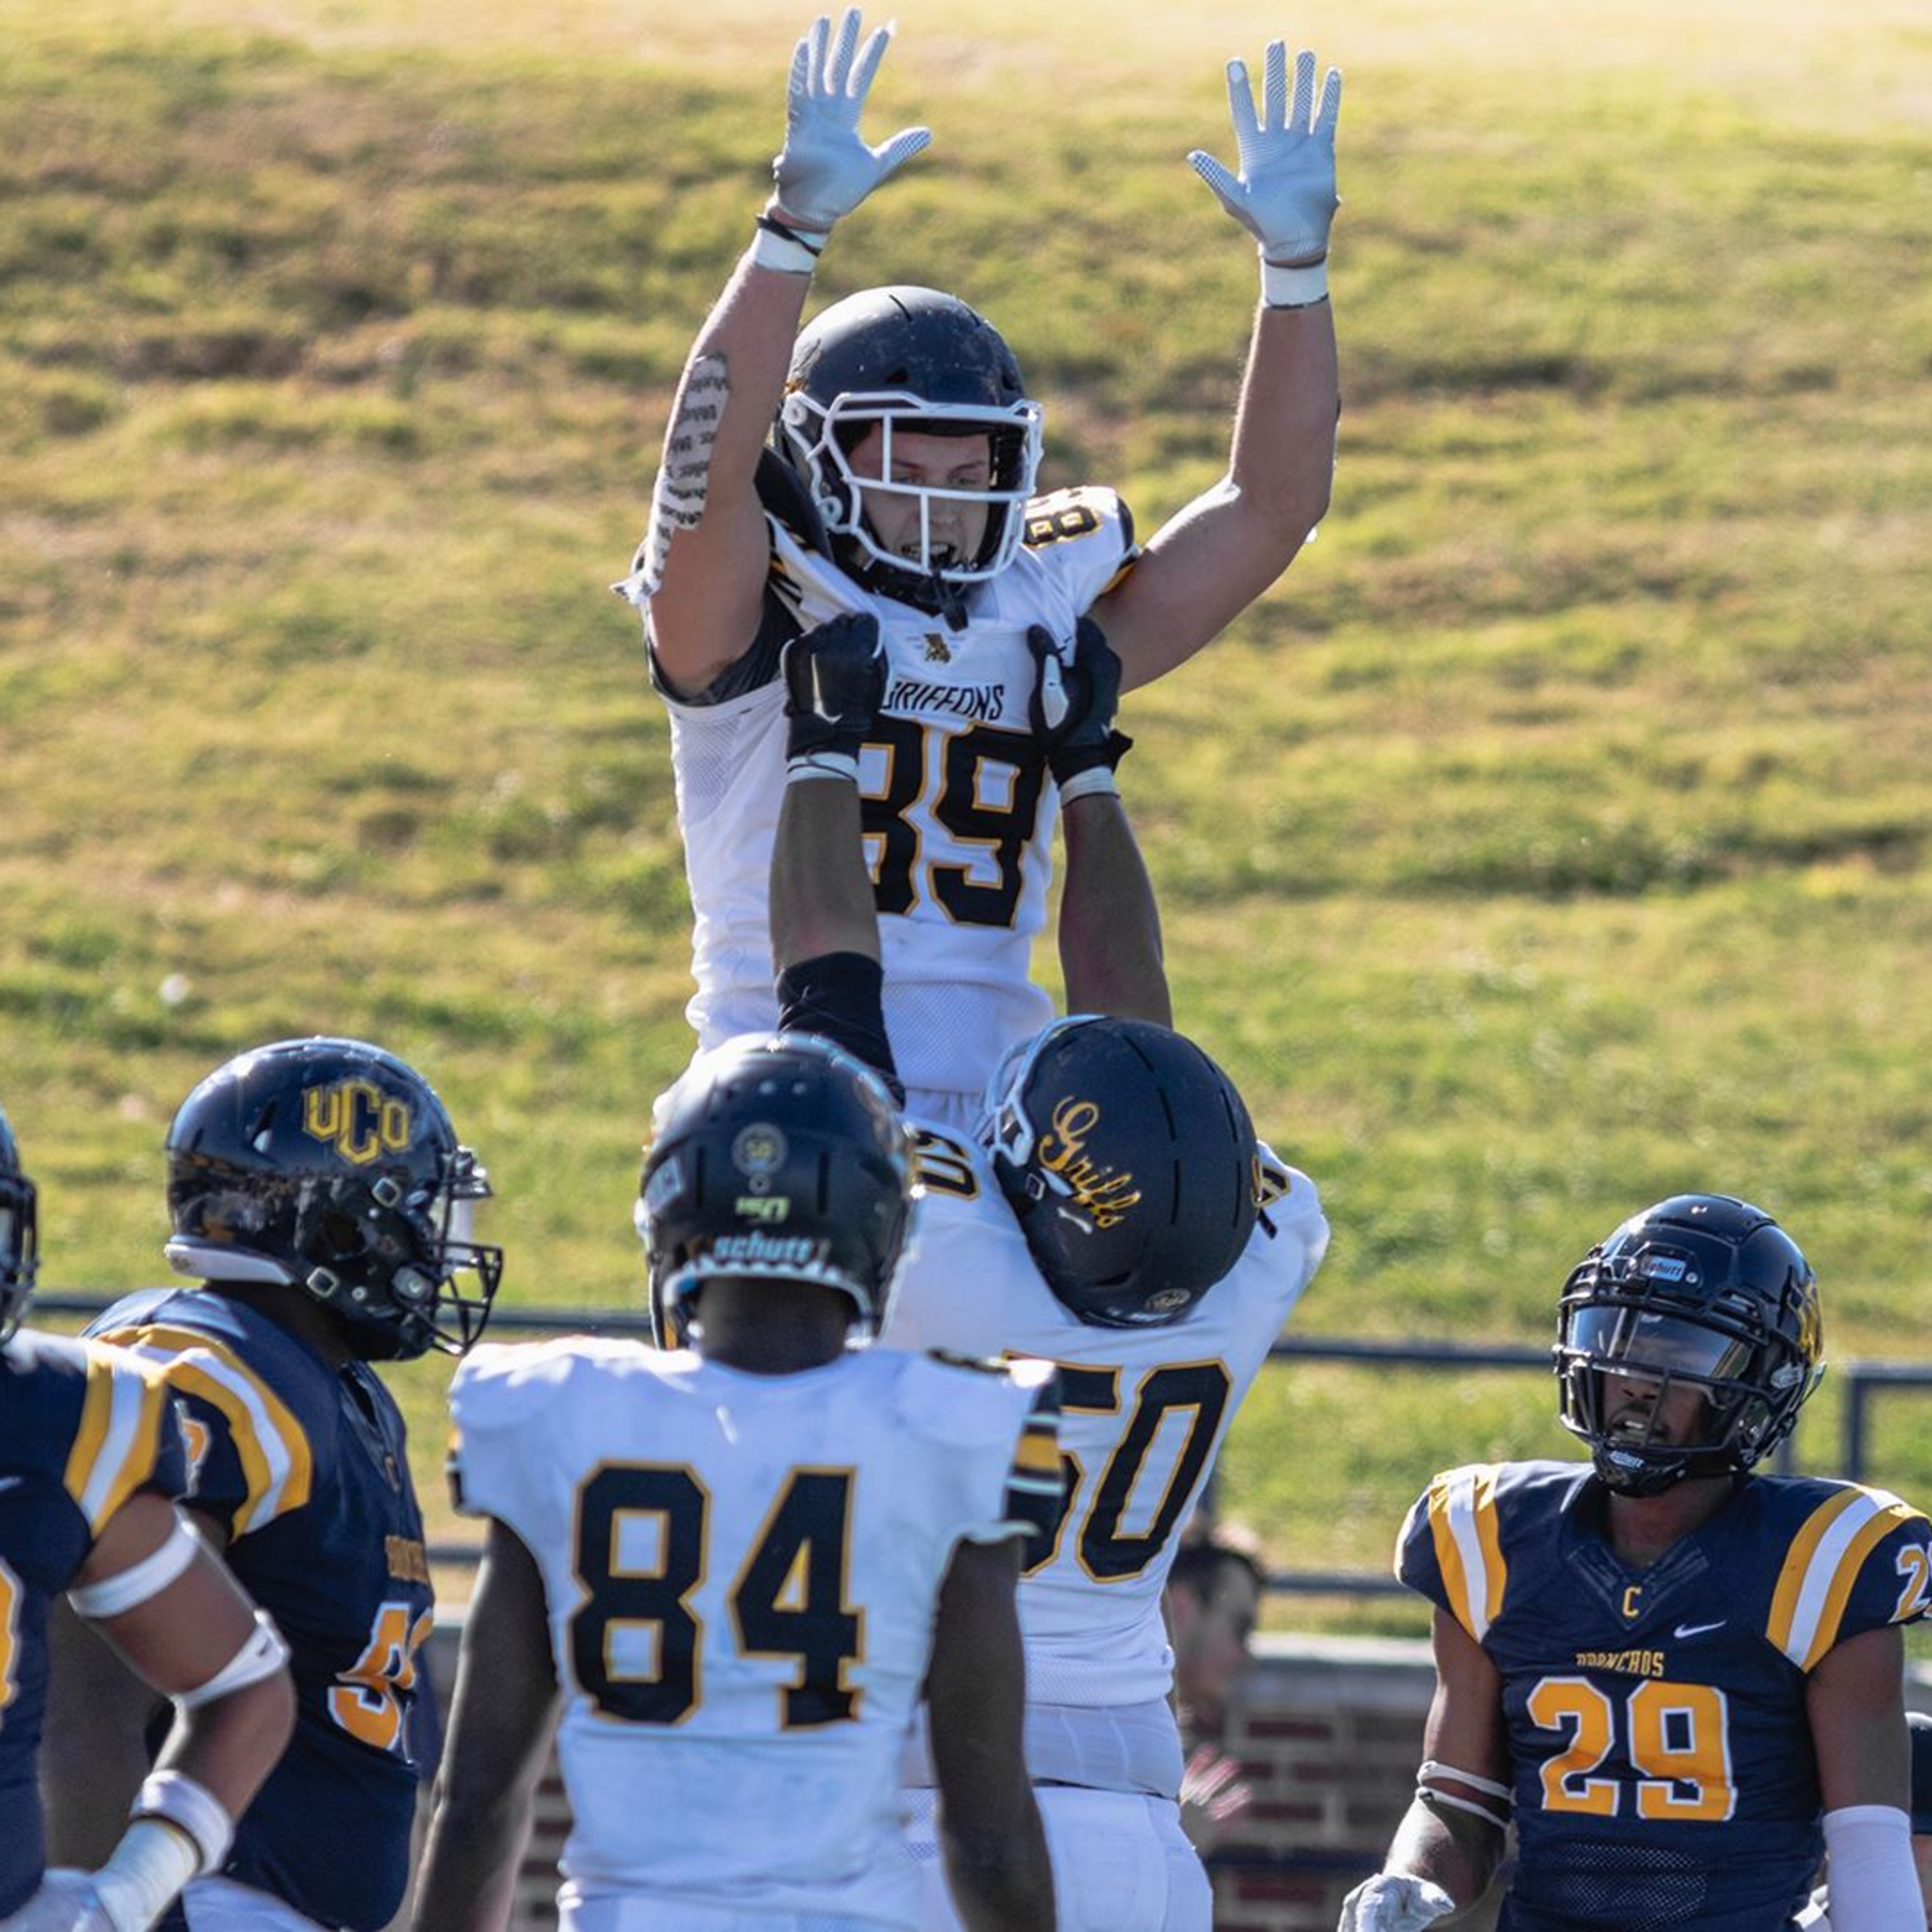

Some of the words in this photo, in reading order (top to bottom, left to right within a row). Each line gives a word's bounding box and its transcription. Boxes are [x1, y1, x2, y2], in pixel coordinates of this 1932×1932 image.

[303, 1078, 411, 1166] UCO
[1039, 1095, 1141, 1229] Griffs
[565, 1459, 866, 1732] 84
[1623, 1586, 1643, 1617] C
[1888, 1542, 1932, 1624] 2
[1526, 1676, 1738, 1821] 29
